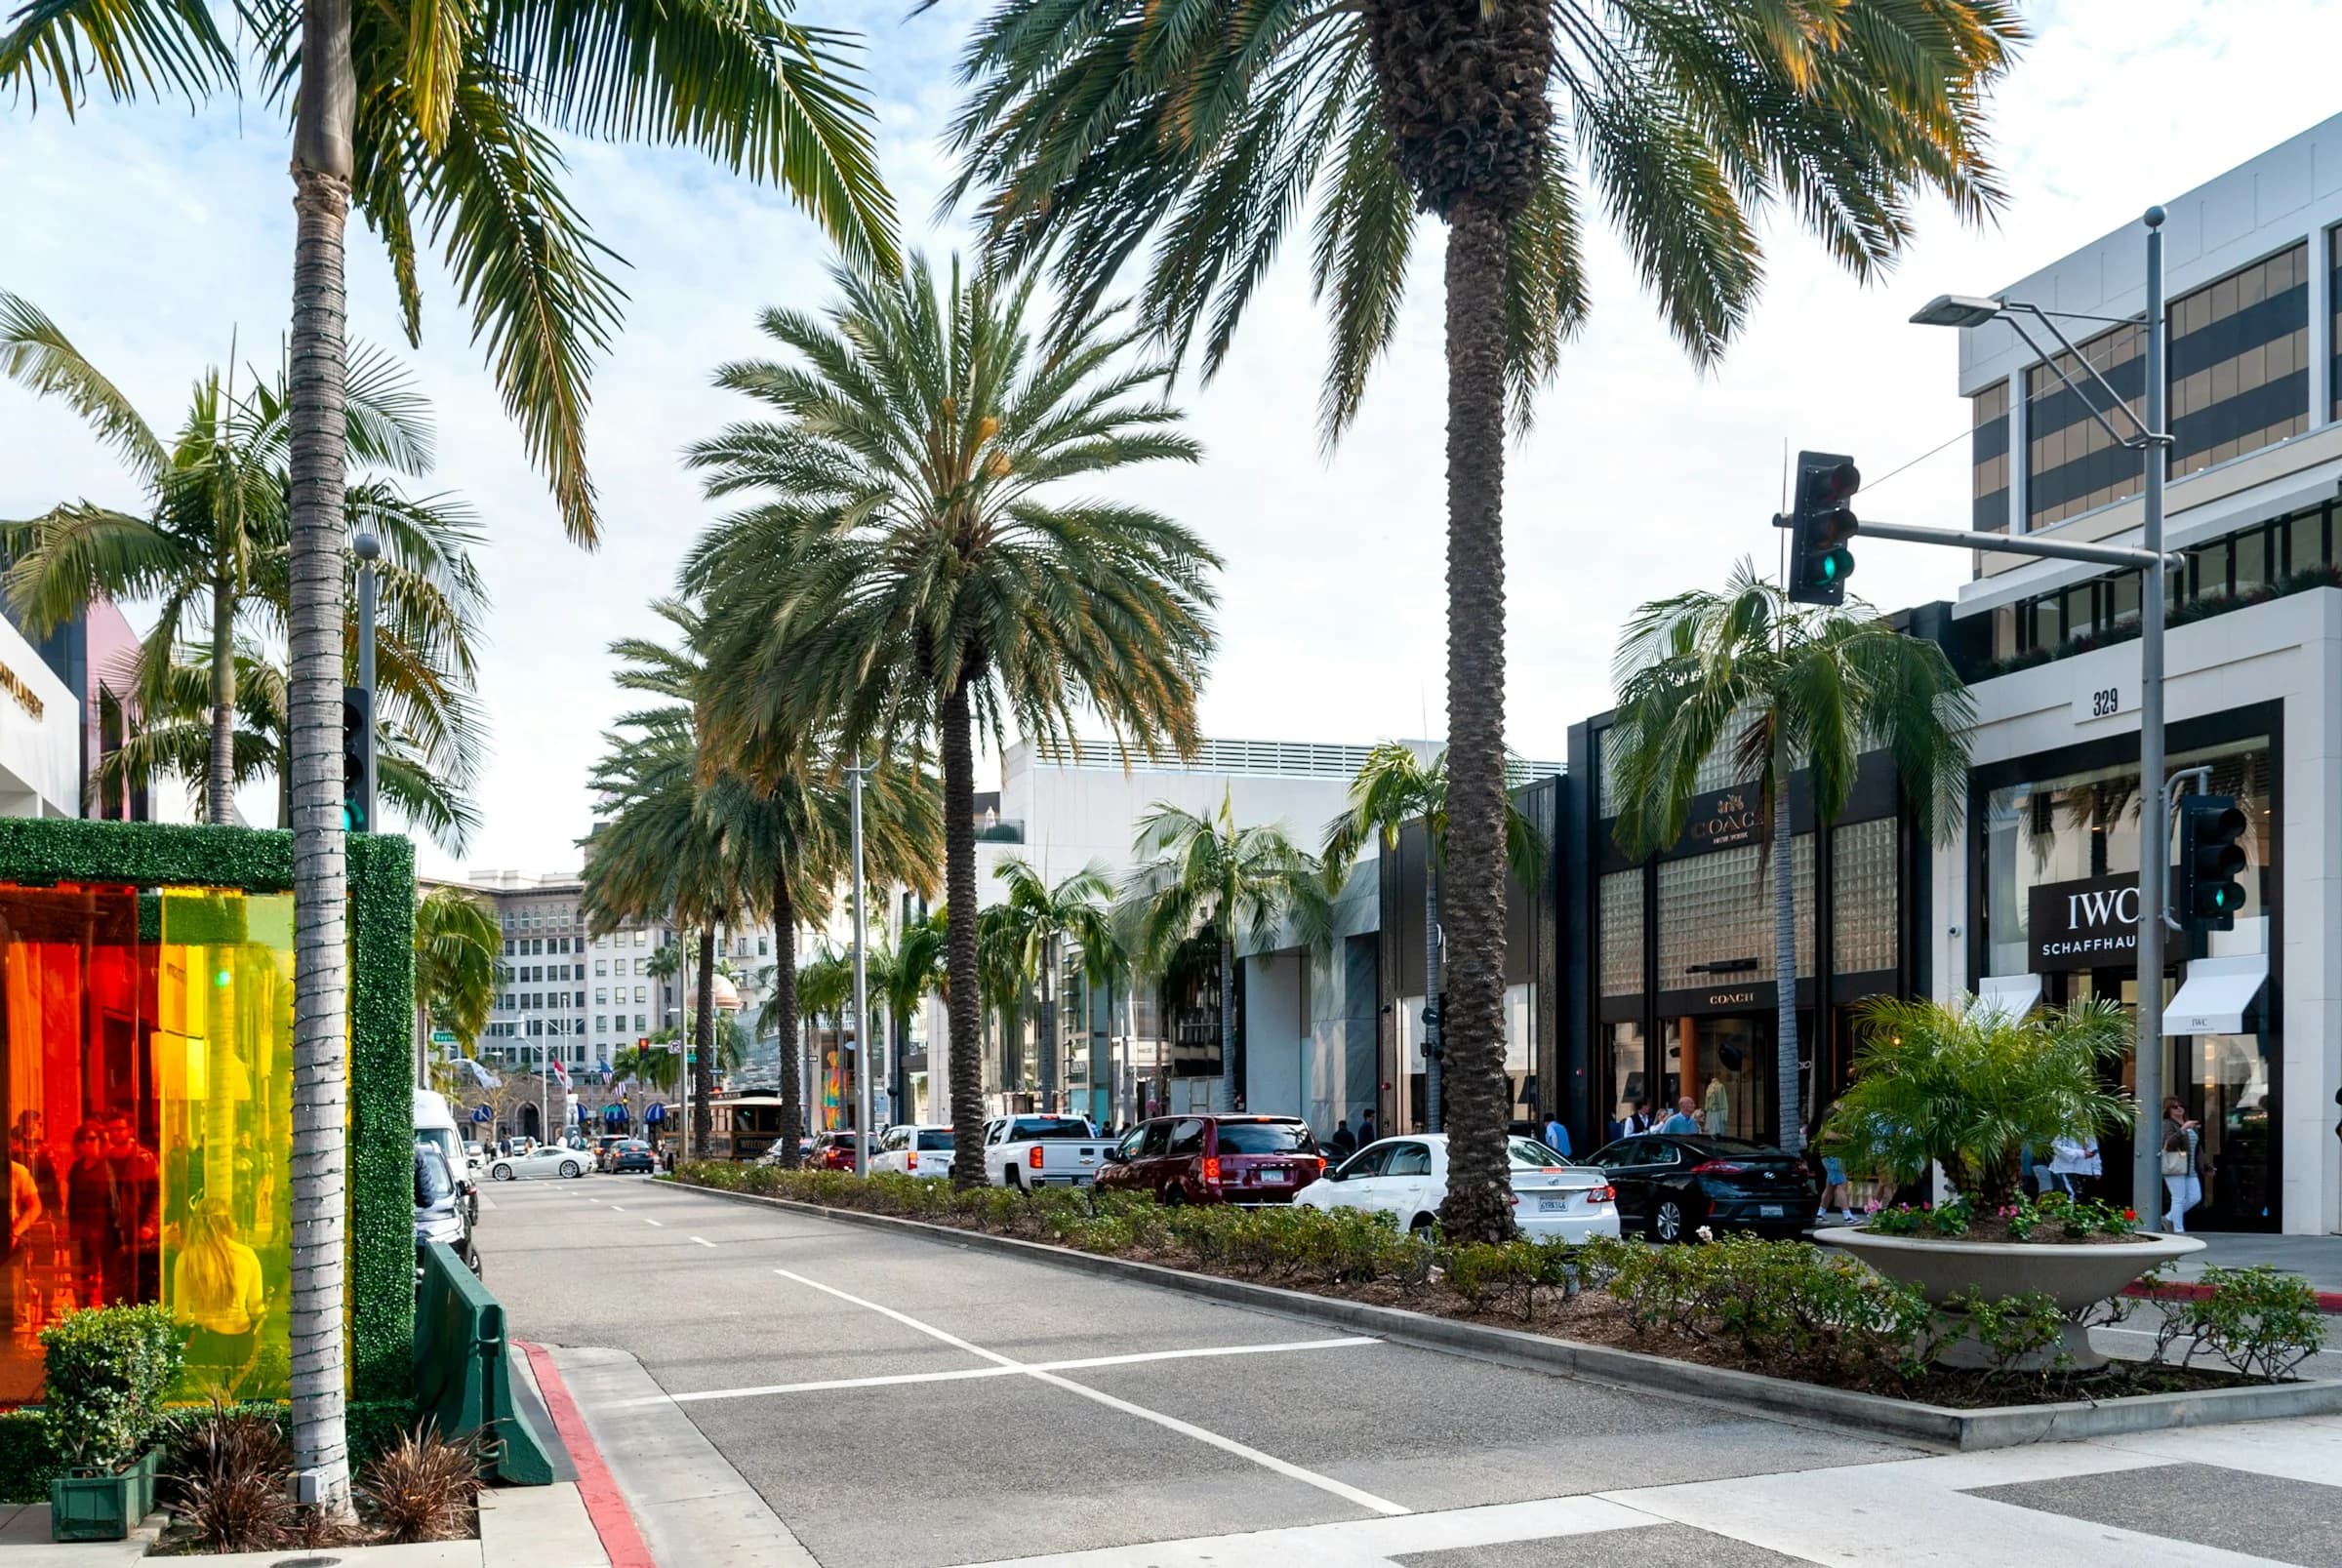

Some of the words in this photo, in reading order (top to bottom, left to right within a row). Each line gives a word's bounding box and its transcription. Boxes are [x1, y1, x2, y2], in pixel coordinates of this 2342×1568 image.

[2093, 687, 2118, 716] 329
[2068, 887, 2139, 930] IWC
[2042, 935, 2136, 955] SCHAFFHAU
[1710, 992, 1755, 1005] COACH
[2192, 1018, 2209, 1027] IWC
